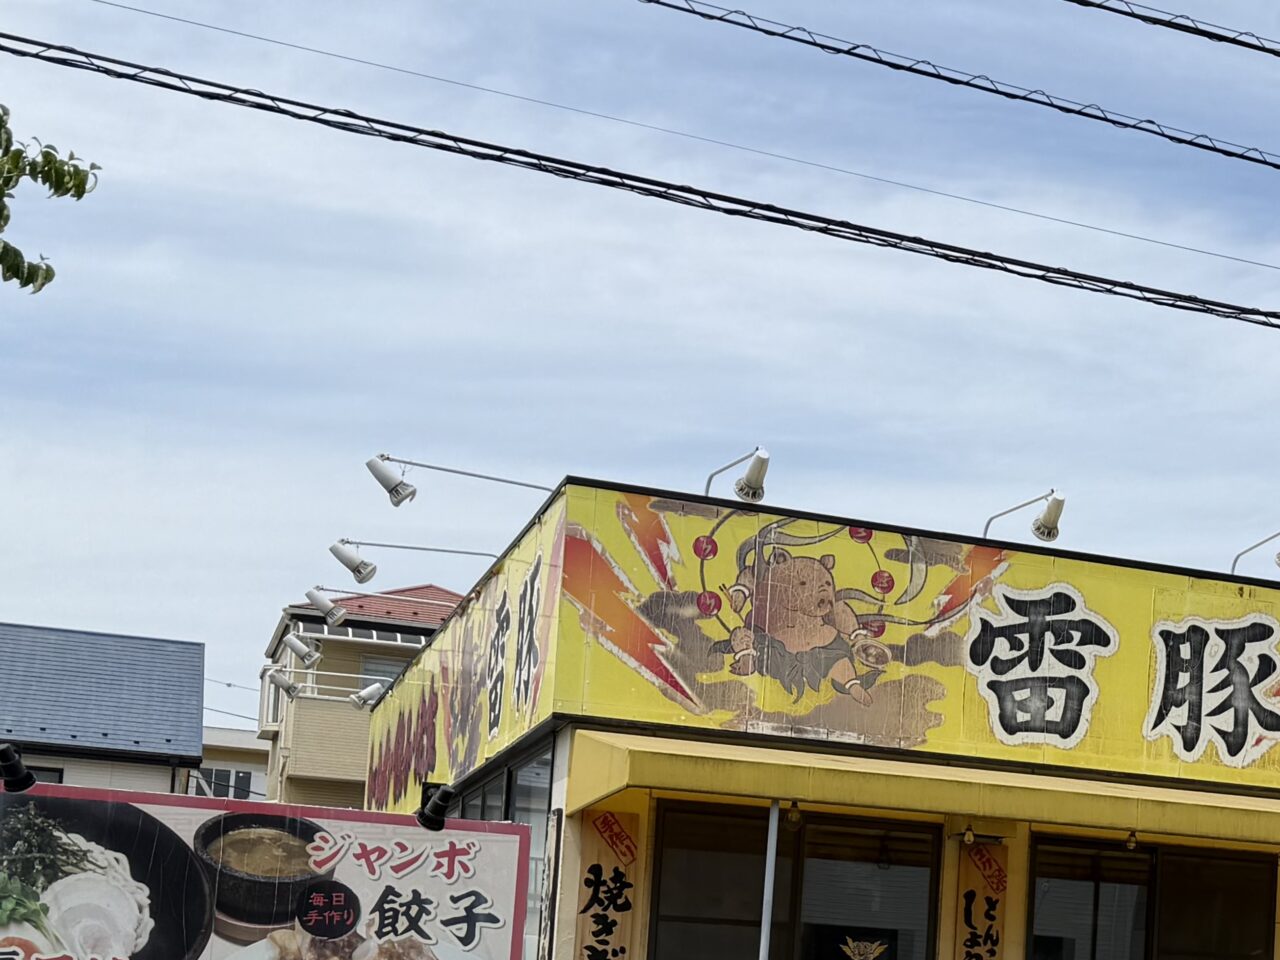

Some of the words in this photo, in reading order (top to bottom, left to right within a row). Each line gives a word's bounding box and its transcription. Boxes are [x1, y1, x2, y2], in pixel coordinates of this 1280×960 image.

[311, 833, 477, 880] ジャンボ
[309, 892, 345, 906] 毎日
[303, 909, 356, 926] 手作り
[369, 885, 501, 947] 餃子
